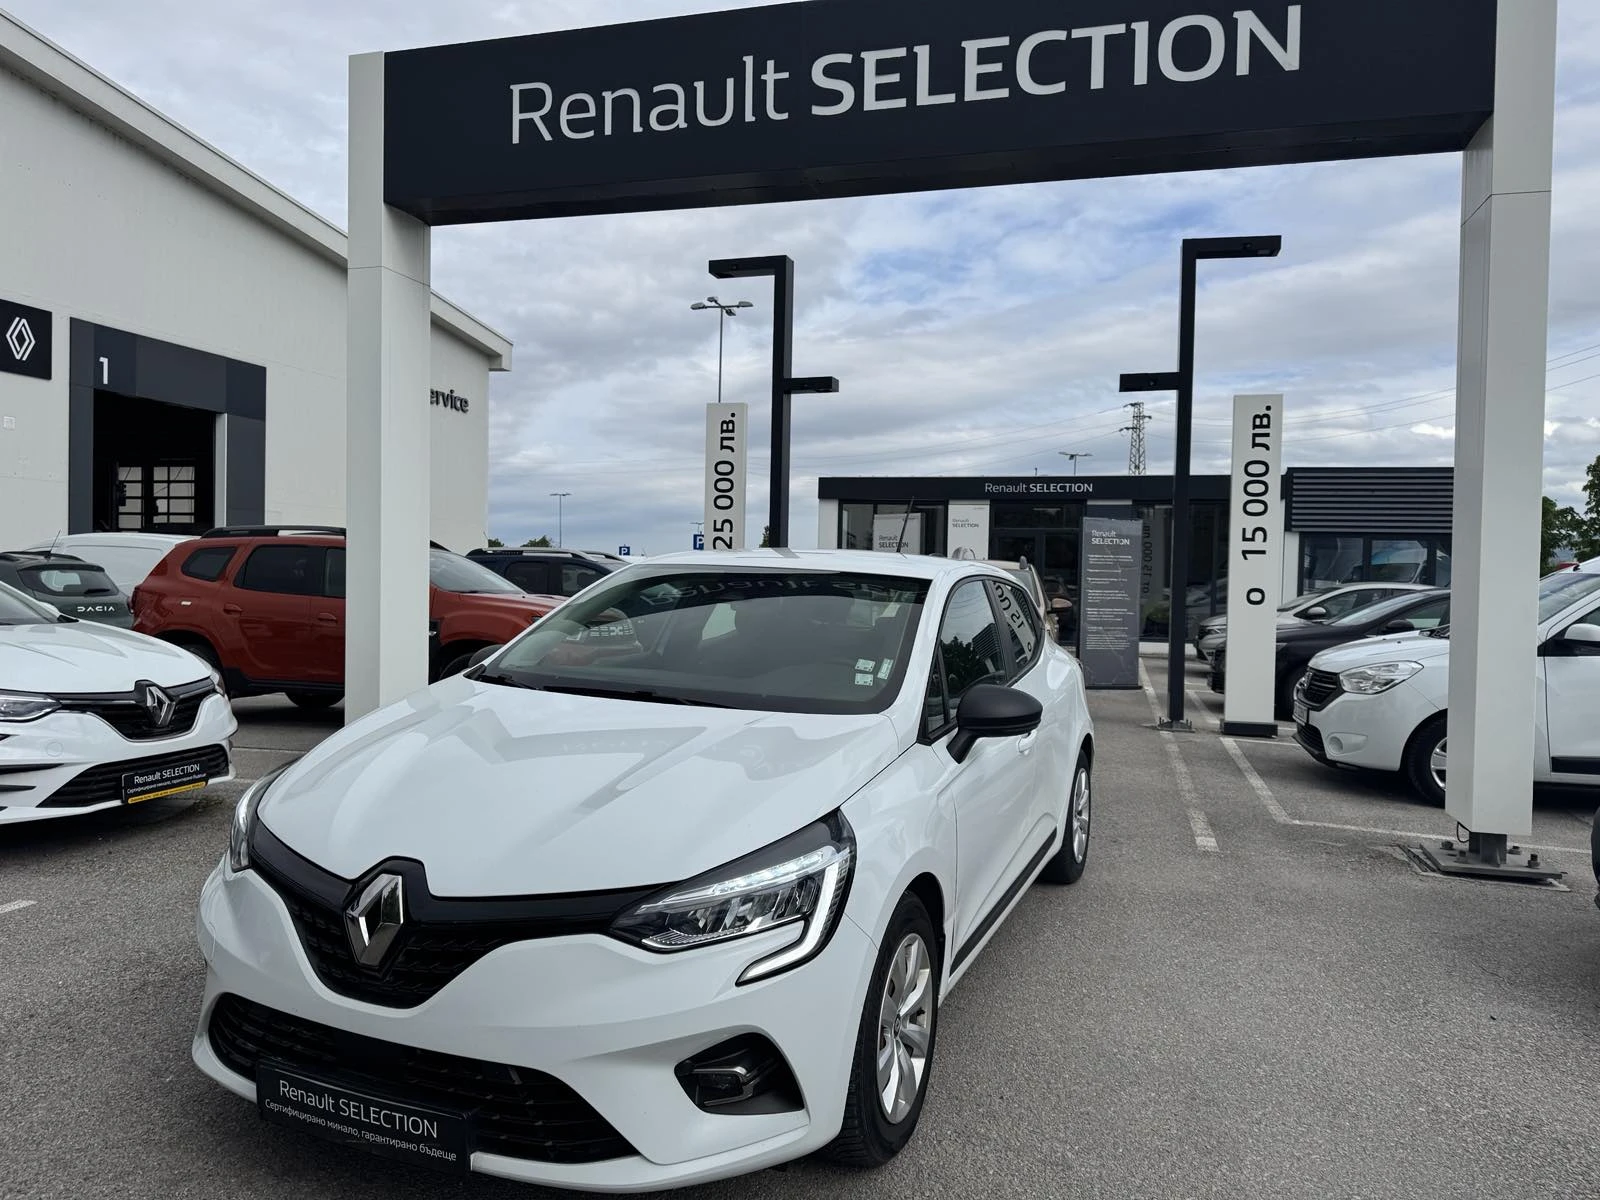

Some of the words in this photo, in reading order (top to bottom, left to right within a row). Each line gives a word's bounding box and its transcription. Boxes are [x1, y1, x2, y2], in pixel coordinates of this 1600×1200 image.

[509, 55, 791, 145] Renault
[810, 4, 1303, 117] SELECTION
[99, 356, 109, 385] 1
[429, 388, 469, 413] ervice
[720, 412, 736, 453] лв.
[1251, 405, 1272, 451] лв.
[713, 460, 735, 511] 000
[984, 482, 1028, 493] Renault
[1029, 482, 1094, 493] SELECTION
[1242, 460, 1270, 517] 000
[621, 547, 628, 555] P
[712, 518, 734, 550] 25
[1241, 526, 1267, 561] 15
[134, 771, 161, 785] Renault
[162, 763, 201, 779] SELECTION
[279, 1079, 336, 1113] Renault
[338, 1098, 438, 1139] SELECTION
[265, 1099, 327, 1127] Сертифицирано
[327, 1120, 360, 1138] минало,
[361, 1130, 418, 1152] гарантирано
[419, 1143, 457, 1161] бъдеще
